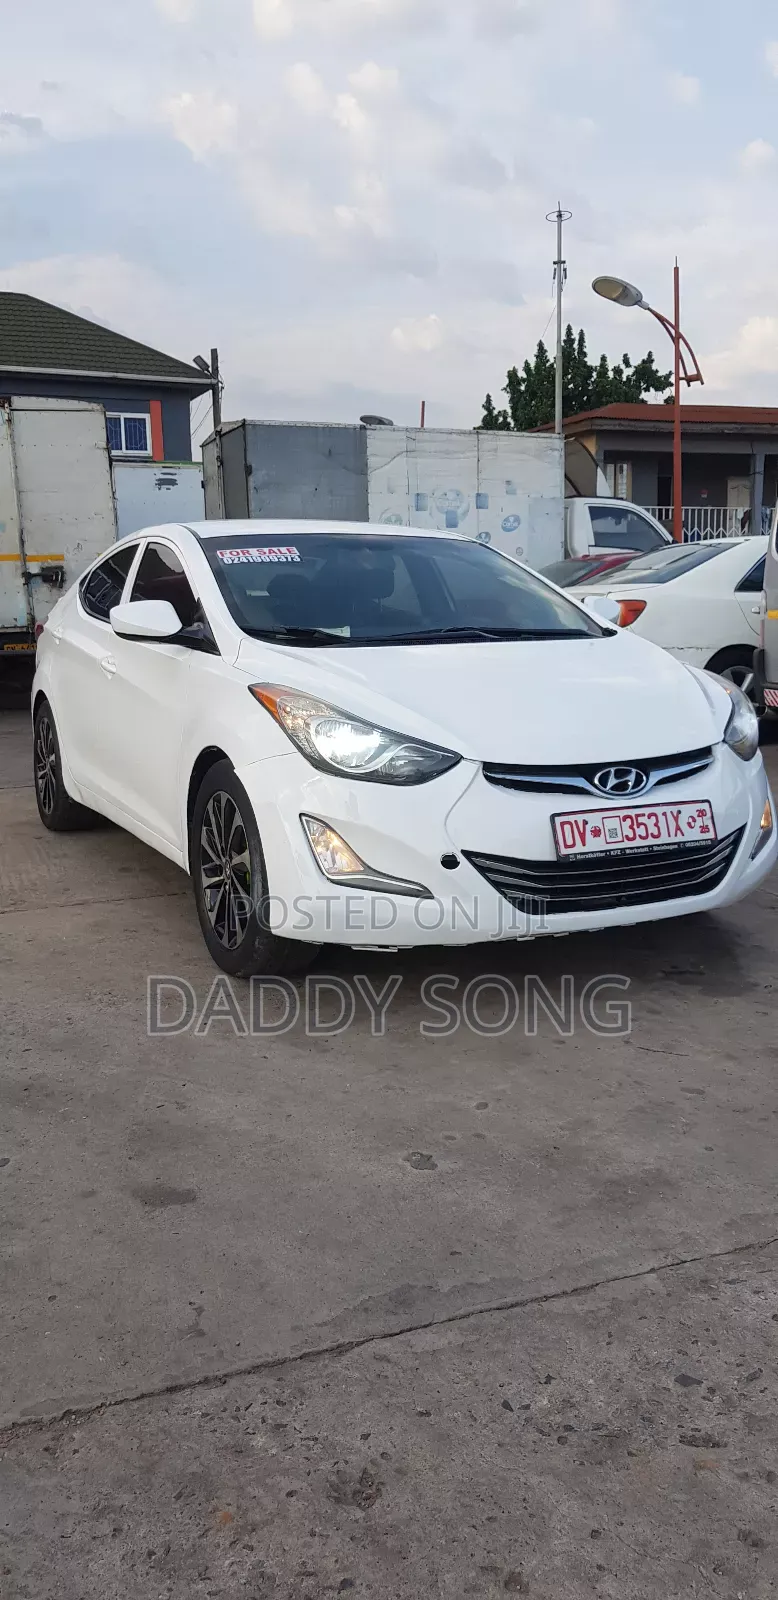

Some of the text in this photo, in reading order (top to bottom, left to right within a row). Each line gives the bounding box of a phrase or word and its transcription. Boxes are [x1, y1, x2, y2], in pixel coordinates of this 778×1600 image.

[219, 547, 298, 557] FOR SALE
[560, 811, 685, 849] DV 3531X
